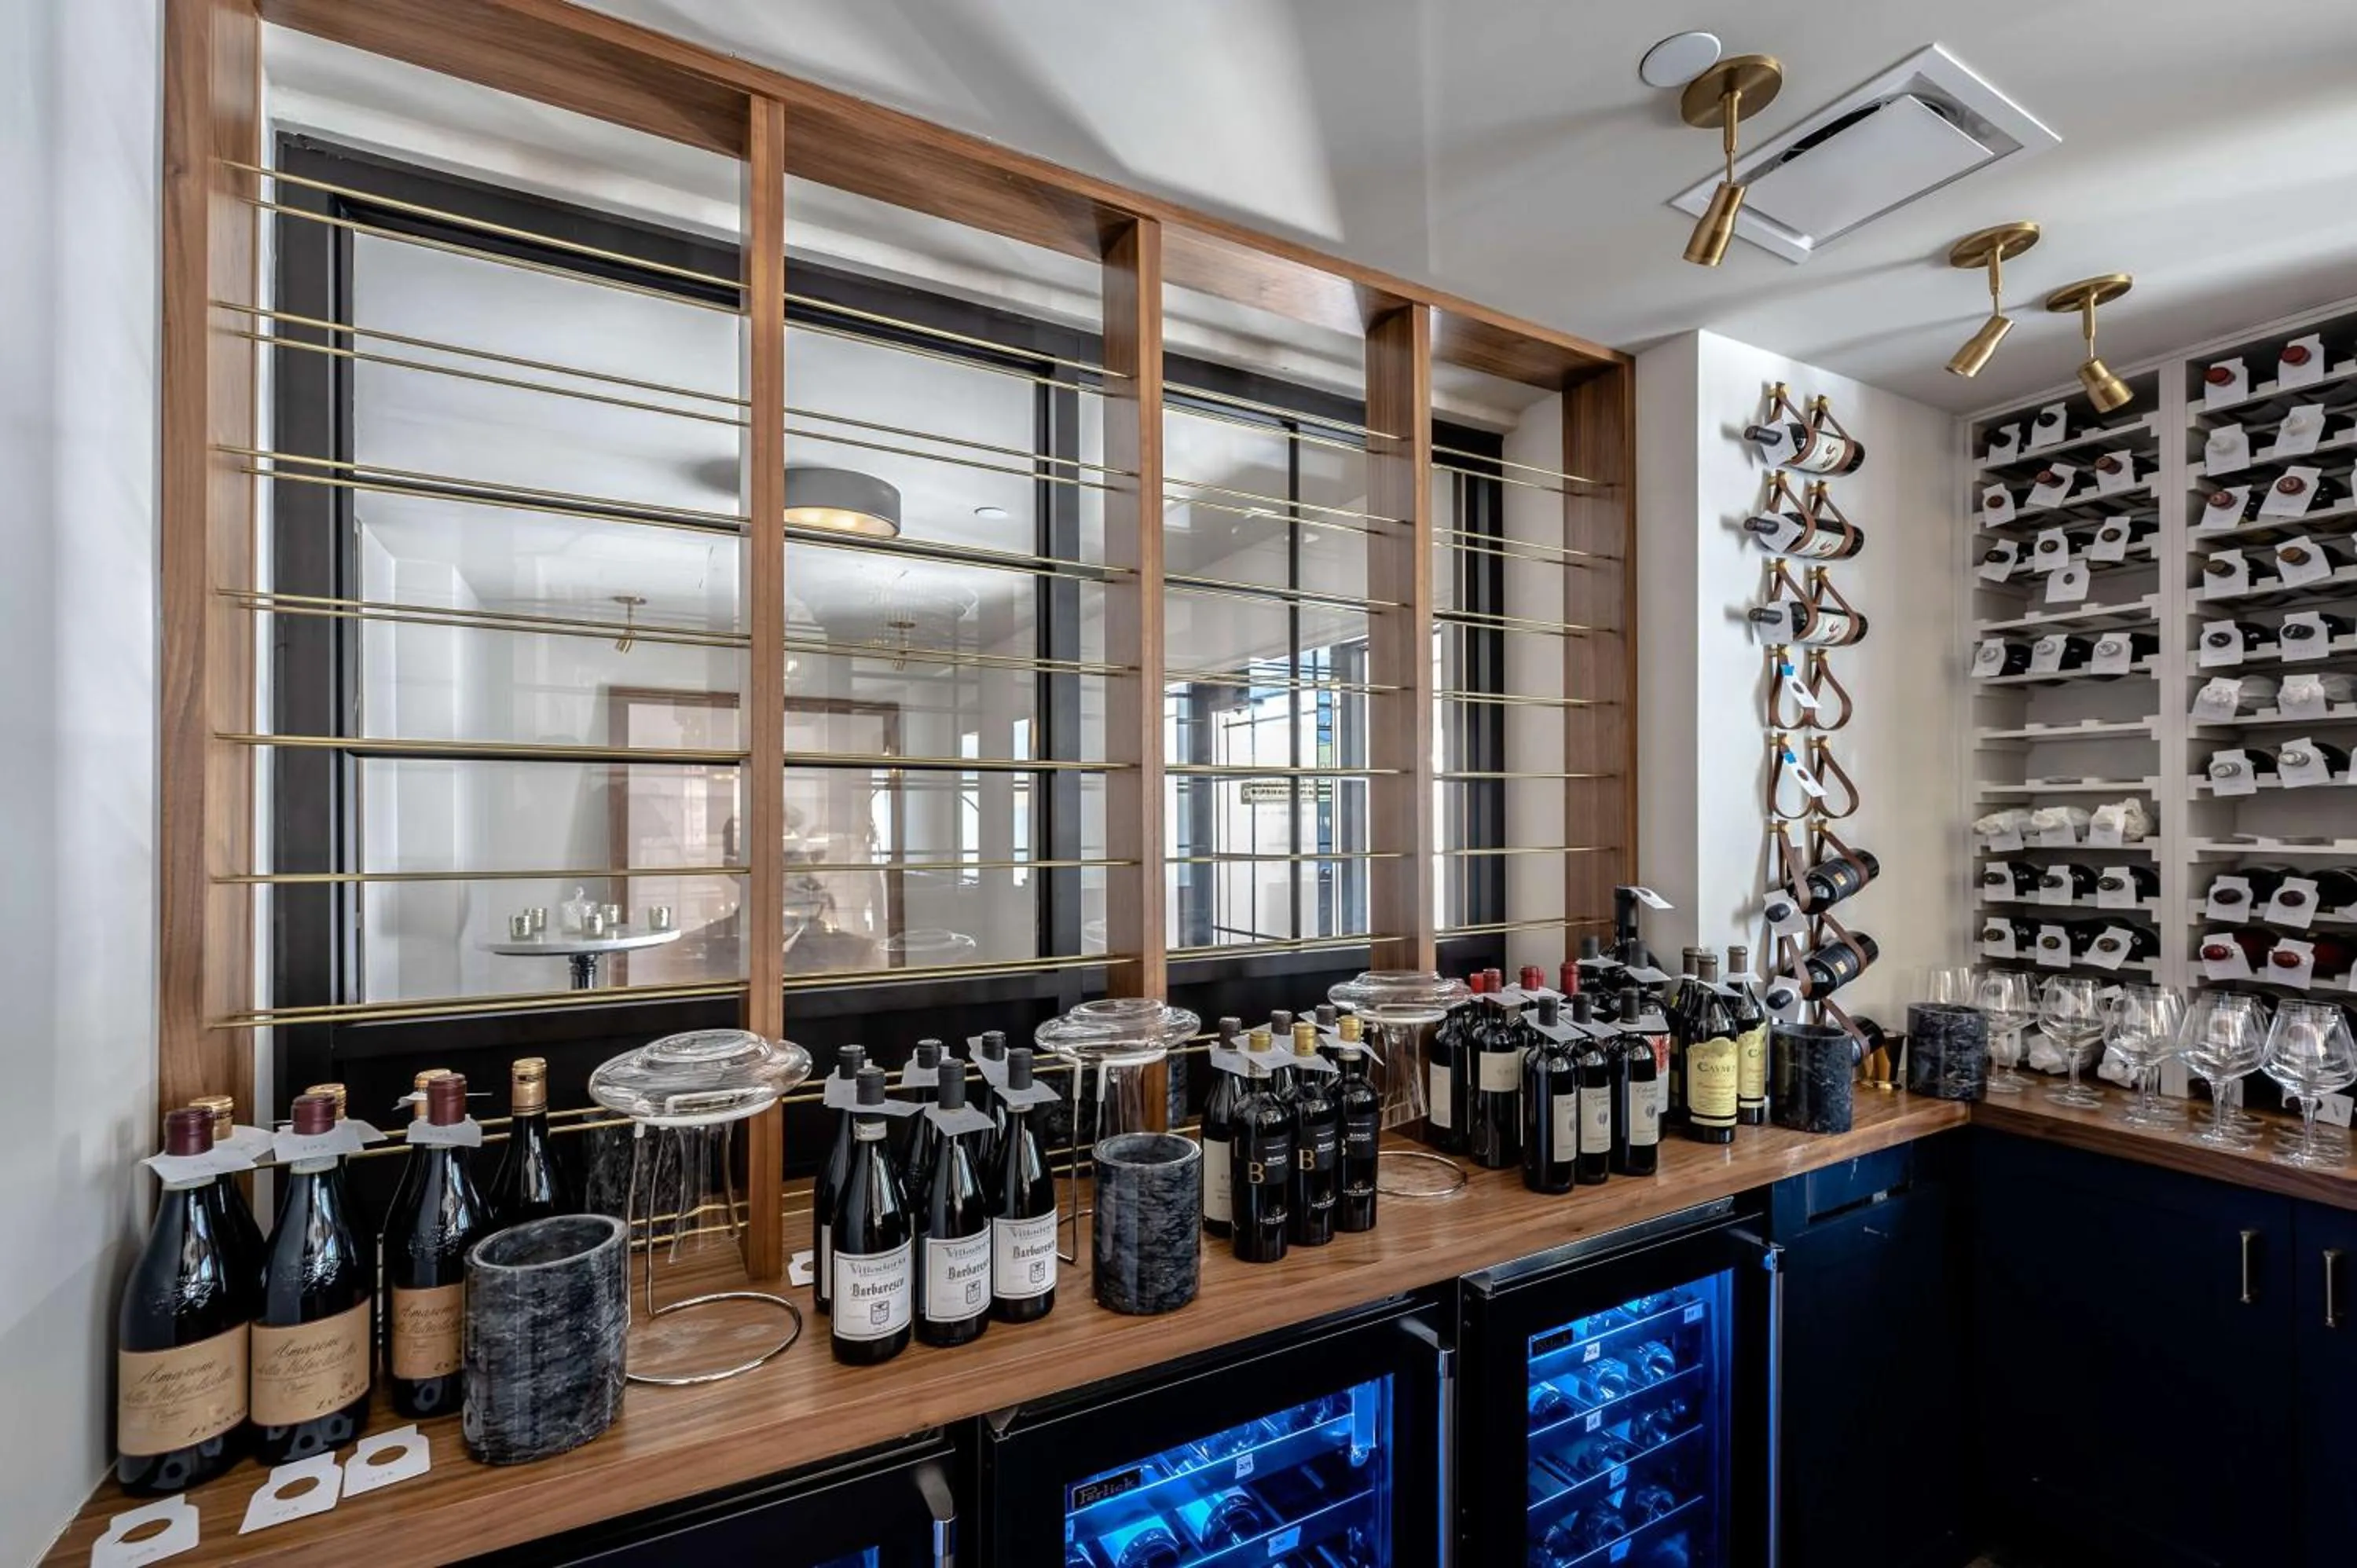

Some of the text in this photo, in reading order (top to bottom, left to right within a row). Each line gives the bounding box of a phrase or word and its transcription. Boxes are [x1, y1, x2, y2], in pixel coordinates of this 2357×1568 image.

[1299, 1149, 1315, 1171] B
[1248, 1162, 1264, 1184] B
[851, 1277, 904, 1297] Barbaresco
